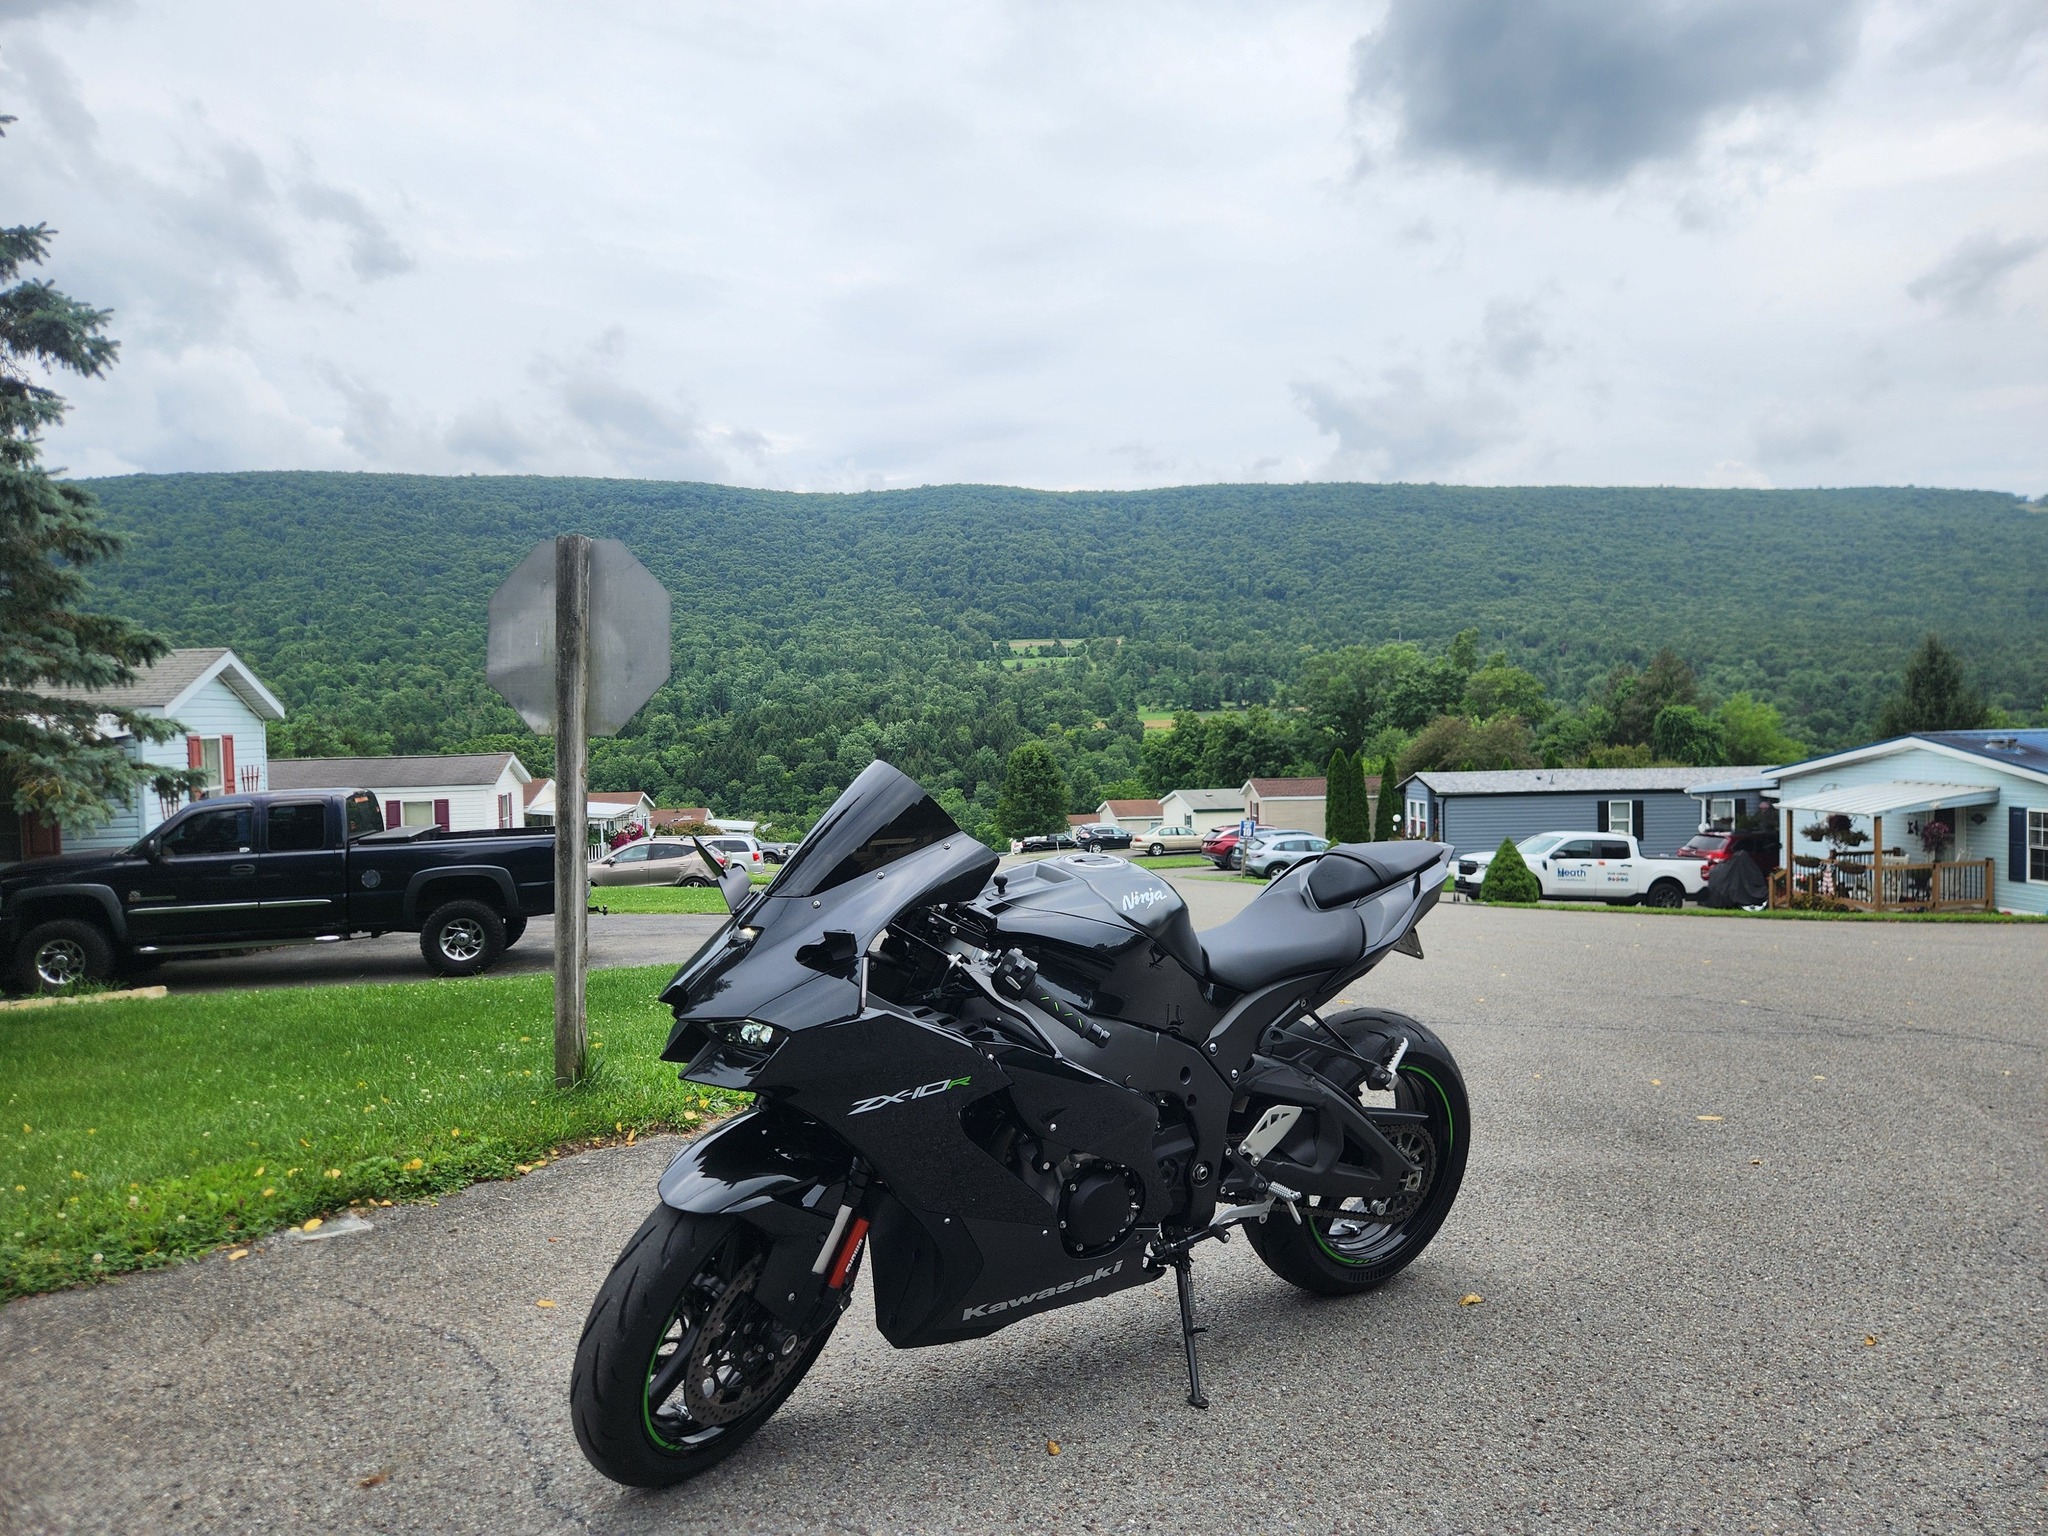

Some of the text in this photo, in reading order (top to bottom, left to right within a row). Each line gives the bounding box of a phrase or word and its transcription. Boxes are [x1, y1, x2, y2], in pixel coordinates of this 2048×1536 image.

[1122, 887, 1168, 911] Ninja
[847, 1075, 972, 1116] ZX-10R
[962, 1259, 1124, 1321] Kawasaki
